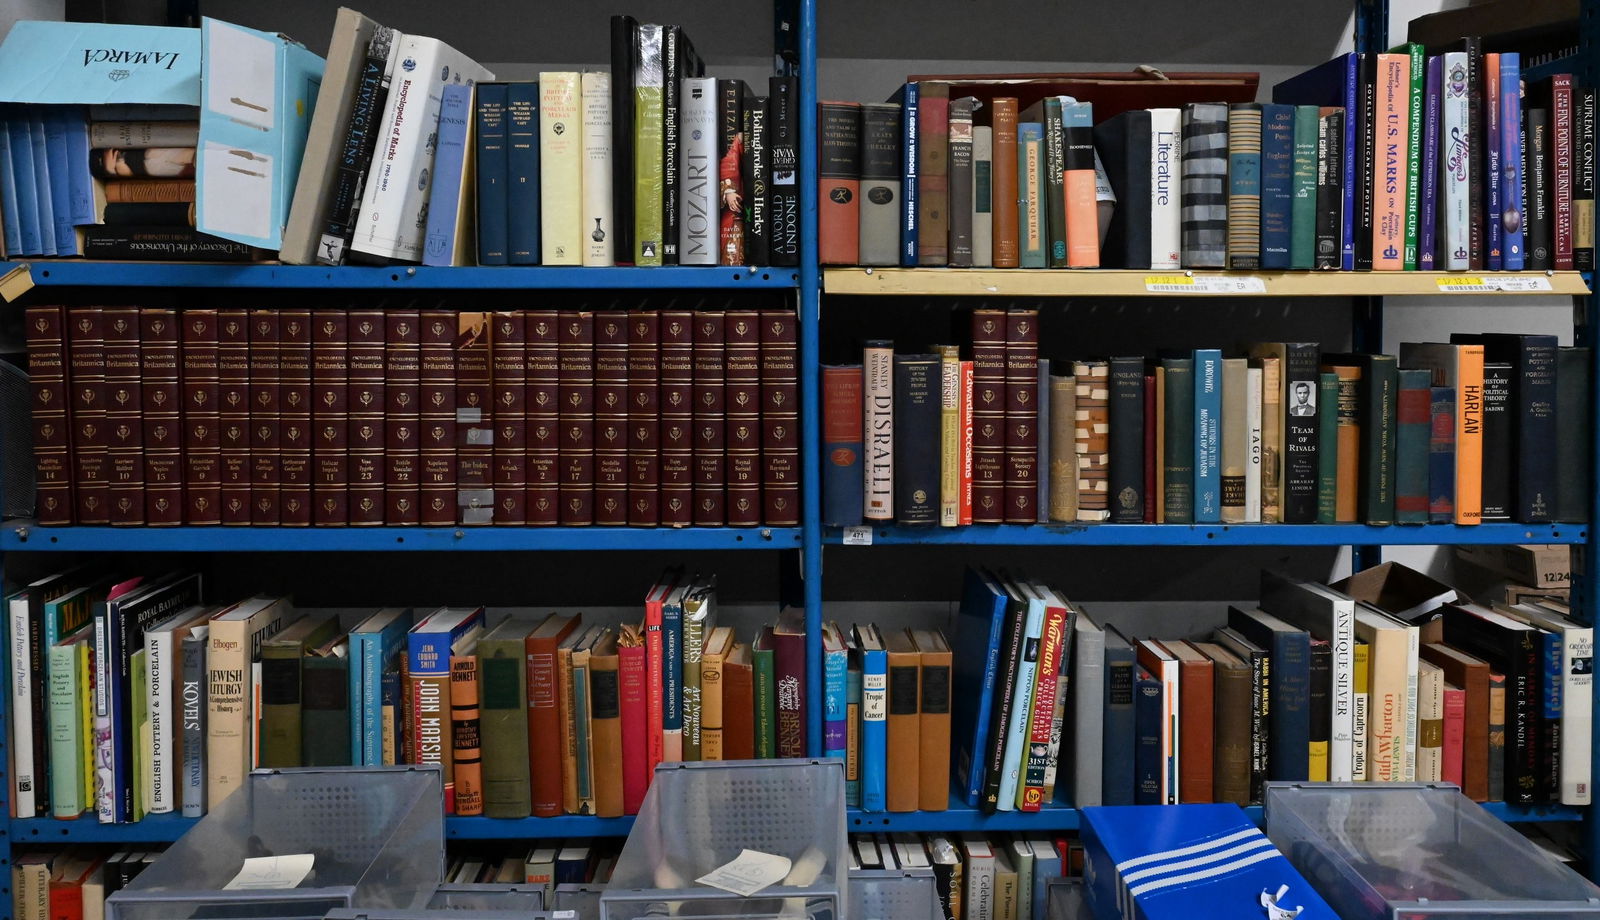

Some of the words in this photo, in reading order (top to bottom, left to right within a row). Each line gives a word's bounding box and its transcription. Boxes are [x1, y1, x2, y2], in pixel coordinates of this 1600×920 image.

[83, 48, 179, 70] LAMARCA
[367, 62, 379, 74] A
[667, 32, 676, 78] GODDEN'S
[667, 81, 675, 97] Guide
[1386, 61, 1396, 103] Encyclopedia
[354, 78, 377, 125] LIVING
[394, 79, 412, 127] Encyclopedia
[1364, 84, 1372, 120] KOVELS'
[665, 107, 677, 142] English
[726, 90, 736, 171] ELIZABETH
[1318, 117, 1328, 138] william
[1330, 116, 1338, 127] the
[1386, 113, 1399, 140] U.S.
[1410, 95, 1420, 159] COMPENDIUM
[1557, 108, 1569, 127] FINE
[1583, 94, 1594, 139] SUPREME
[392, 128, 401, 136] of
[750, 109, 764, 179] Bolingbroke
[1329, 128, 1338, 154] selected
[1364, 123, 1372, 170] AMERICAN
[1534, 125, 1544, 152] Morgan
[1556, 128, 1569, 152] POINTS
[344, 130, 362, 166] LENS
[387, 137, 400, 161] Marks
[772, 149, 796, 158] WAR
[1053, 117, 1065, 185] SHAKESPEARE
[1318, 139, 1328, 159] carlos
[1557, 153, 1569, 168] OF
[666, 142, 677, 185] Porcelain
[1029, 148, 1037, 185] GEORGE
[1157, 131, 1173, 206] Literature
[1318, 160, 1328, 186] williams
[1329, 155, 1338, 178] letters
[1385, 143, 1398, 194] MARKS
[1410, 161, 1419, 174] OF
[1535, 154, 1544, 188] Benjamin
[1583, 142, 1594, 193] CONFLICT
[1388, 197, 1395, 209] ON
[1409, 175, 1418, 215] BRITISH
[1536, 189, 1545, 220] Franklin
[1557, 169, 1570, 212] FURNITURE
[689, 153, 707, 258] MOZART
[750, 197, 764, 236] Harley
[772, 194, 784, 242] WORLD
[1029, 191, 1037, 240] FARQUHAR
[785, 196, 797, 255] UNDONE
[1386, 211, 1395, 241] Porcelain
[1408, 216, 1417, 238] CUPS
[773, 246, 784, 255] A
[29, 359, 62, 369] Britannica
[879, 355, 888, 390] STANLEY
[942, 361, 952, 409] LEADERSHIP
[950, 373, 959, 402] GENESIS
[965, 369, 974, 426] Edwardian
[1464, 385, 1480, 434] HARLAN
[1291, 426, 1314, 434] TEAM
[873, 395, 891, 495] DISRAELI
[964, 427, 973, 479] Occasions
[1252, 428, 1260, 465] IAGO
[1288, 444, 1316, 453] RIVALS
[360, 472, 372, 481] 23
[433, 473, 443, 481] 16
[31, 620, 39, 638] HARD
[1011, 622, 1022, 661] COLLECTOR'S
[1335, 610, 1349, 669] ANTIQUE
[31, 639, 40, 671] PRESSED
[213, 639, 238, 651] Elbogen
[366, 639, 375, 651] An
[417, 652, 439, 661] EDWARD
[421, 644, 434, 653] JEAN
[668, 629, 676, 660] AMERICA
[988, 647, 999, 670] English
[1041, 613, 1063, 676] Warman's
[96, 652, 104, 682] PORCELAIN
[150, 639, 160, 697] PORCELAIN
[210, 669, 243, 682] JEWISH
[420, 661, 436, 669] SMITH
[451, 671, 477, 682] BENNETT
[453, 661, 475, 671] ARNOLD
[1023, 666, 1035, 693] NIPPON
[1252, 669, 1261, 686] Story
[1262, 657, 1270, 677] RABBI
[97, 682, 105, 707] STUDIOS
[210, 683, 243, 695] LITURGY
[364, 653, 375, 707] Autobiography
[683, 686, 691, 695] &
[692, 686, 701, 702] Art
[778, 679, 787, 710] Drabble
[1004, 661, 1017, 704] ENCYCLOPEDIA
[1034, 681, 1044, 707] PRICE
[1262, 678, 1270, 686] IN
[1337, 672, 1349, 716] SILVER
[1517, 675, 1526, 697] ERIC
[1551, 675, 1563, 712] Duel
[183, 680, 201, 731] KOVELS'
[420, 680, 440, 713] JOHN
[683, 695, 692, 710] Art
[865, 692, 883, 702] Tropic
[871, 701, 878, 711] of
[1002, 703, 1010, 712] OF
[1037, 678, 1051, 739] COLLECTIBLES
[1045, 679, 1056, 721] ANTIQUES
[1262, 687, 1270, 716] AMERICA
[1517, 700, 1526, 710] R.
[365, 708, 375, 717] of
[366, 717, 375, 729] the
[683, 712, 692, 737] Deco
[691, 704, 701, 746] Nouveau
[864, 711, 883, 719] Cancer
[998, 712, 1009, 739] LIMOGES
[1018, 694, 1030, 734] PORCELAIN
[1031, 708, 1041, 735] GUIDE
[1253, 718, 1261, 734] Wise
[1353, 697, 1366, 736] Capricorn
[1374, 693, 1393, 755] Wharton
[151, 711, 161, 756] POTTERY
[454, 738, 480, 748] BENNETT
[1043, 722, 1053, 739] AND
[1353, 738, 1364, 748] of
[1517, 713, 1526, 750] KANDEL
[1552, 722, 1560, 749] John
[364, 731, 376, 761] Supreme
[994, 738, 1005, 771] PORCELAIN
[1353, 750, 1365, 777] Tropic
[1551, 752, 1560, 788] Lukacs
[152, 759, 162, 803] ENGLISH
[37, 870, 45, 909] LITERARY
[948, 872, 957, 909] SOUL
[1005, 880, 1013, 894] The
